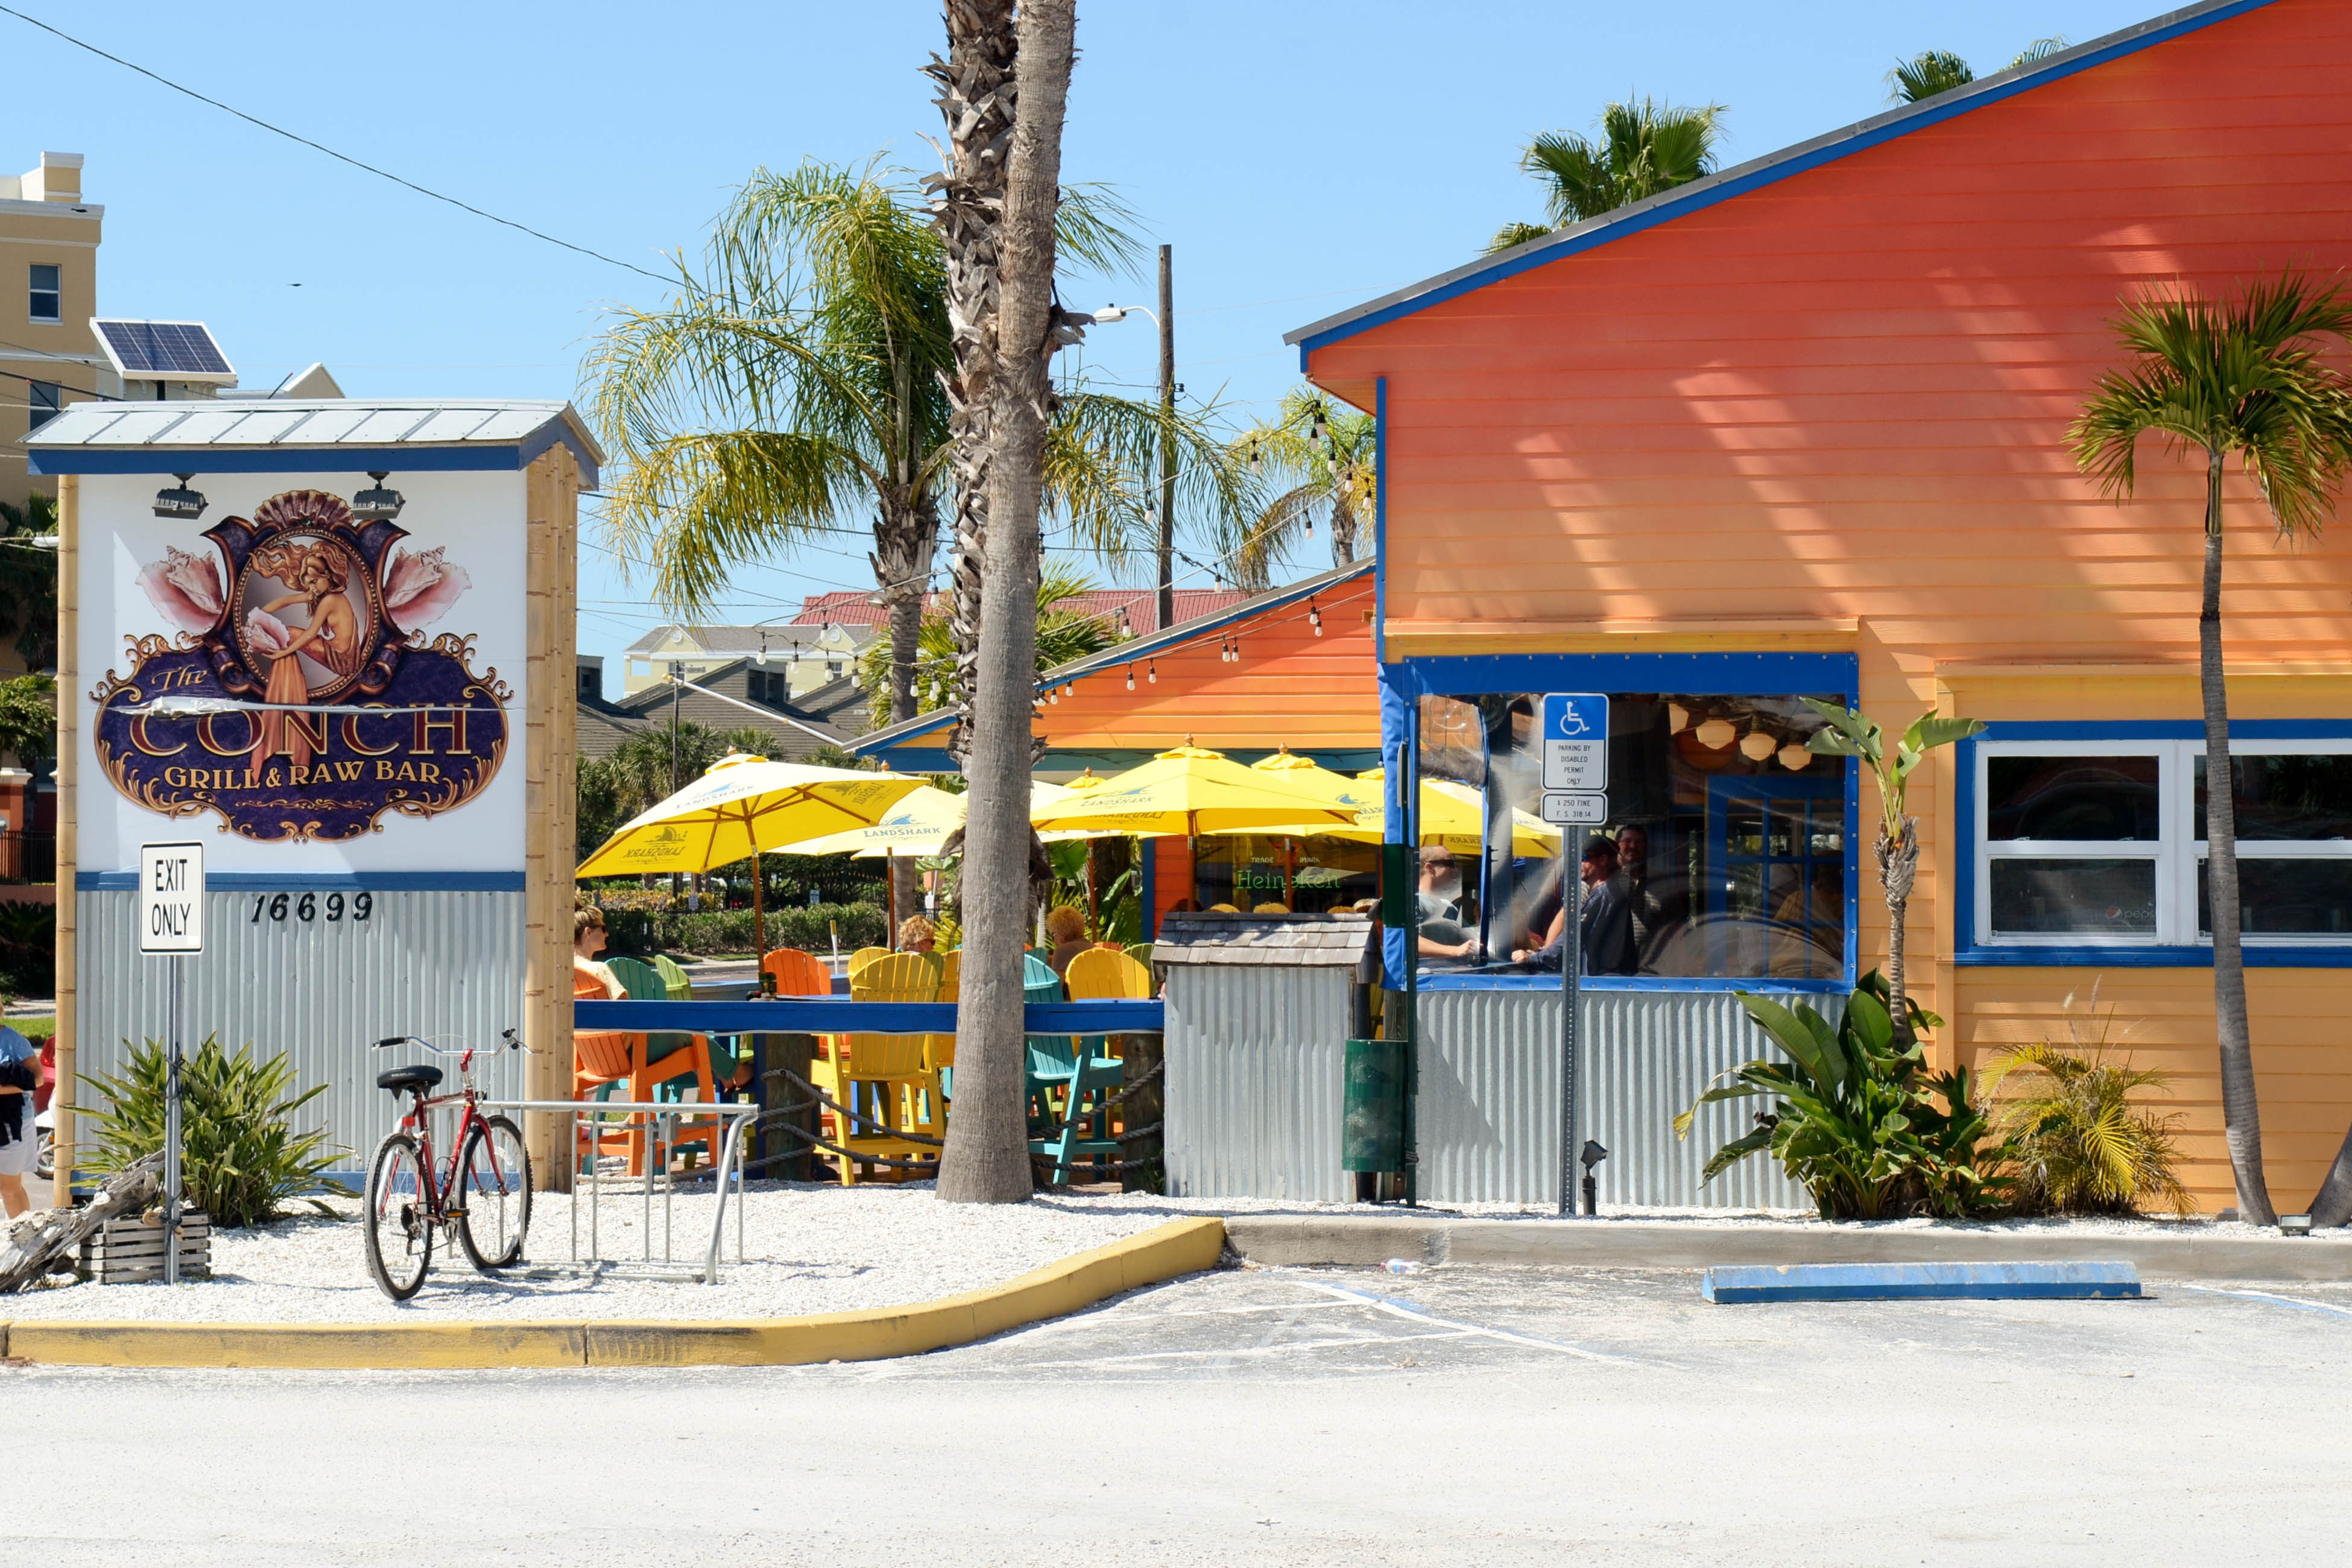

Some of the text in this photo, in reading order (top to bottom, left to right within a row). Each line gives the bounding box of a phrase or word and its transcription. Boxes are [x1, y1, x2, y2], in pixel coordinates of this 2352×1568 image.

[151, 664, 208, 692] The
[129, 702, 472, 756] CONCH
[163, 760, 440, 790] GRILL & RAW BAR
[863, 827, 941, 838] LANDSHARK
[156, 859, 188, 891] EXIT
[1237, 870, 1341, 889] Heineken
[151, 903, 191, 937] ONLY
[251, 892, 373, 923] 16699
[2125, 911, 2155, 920] peps
